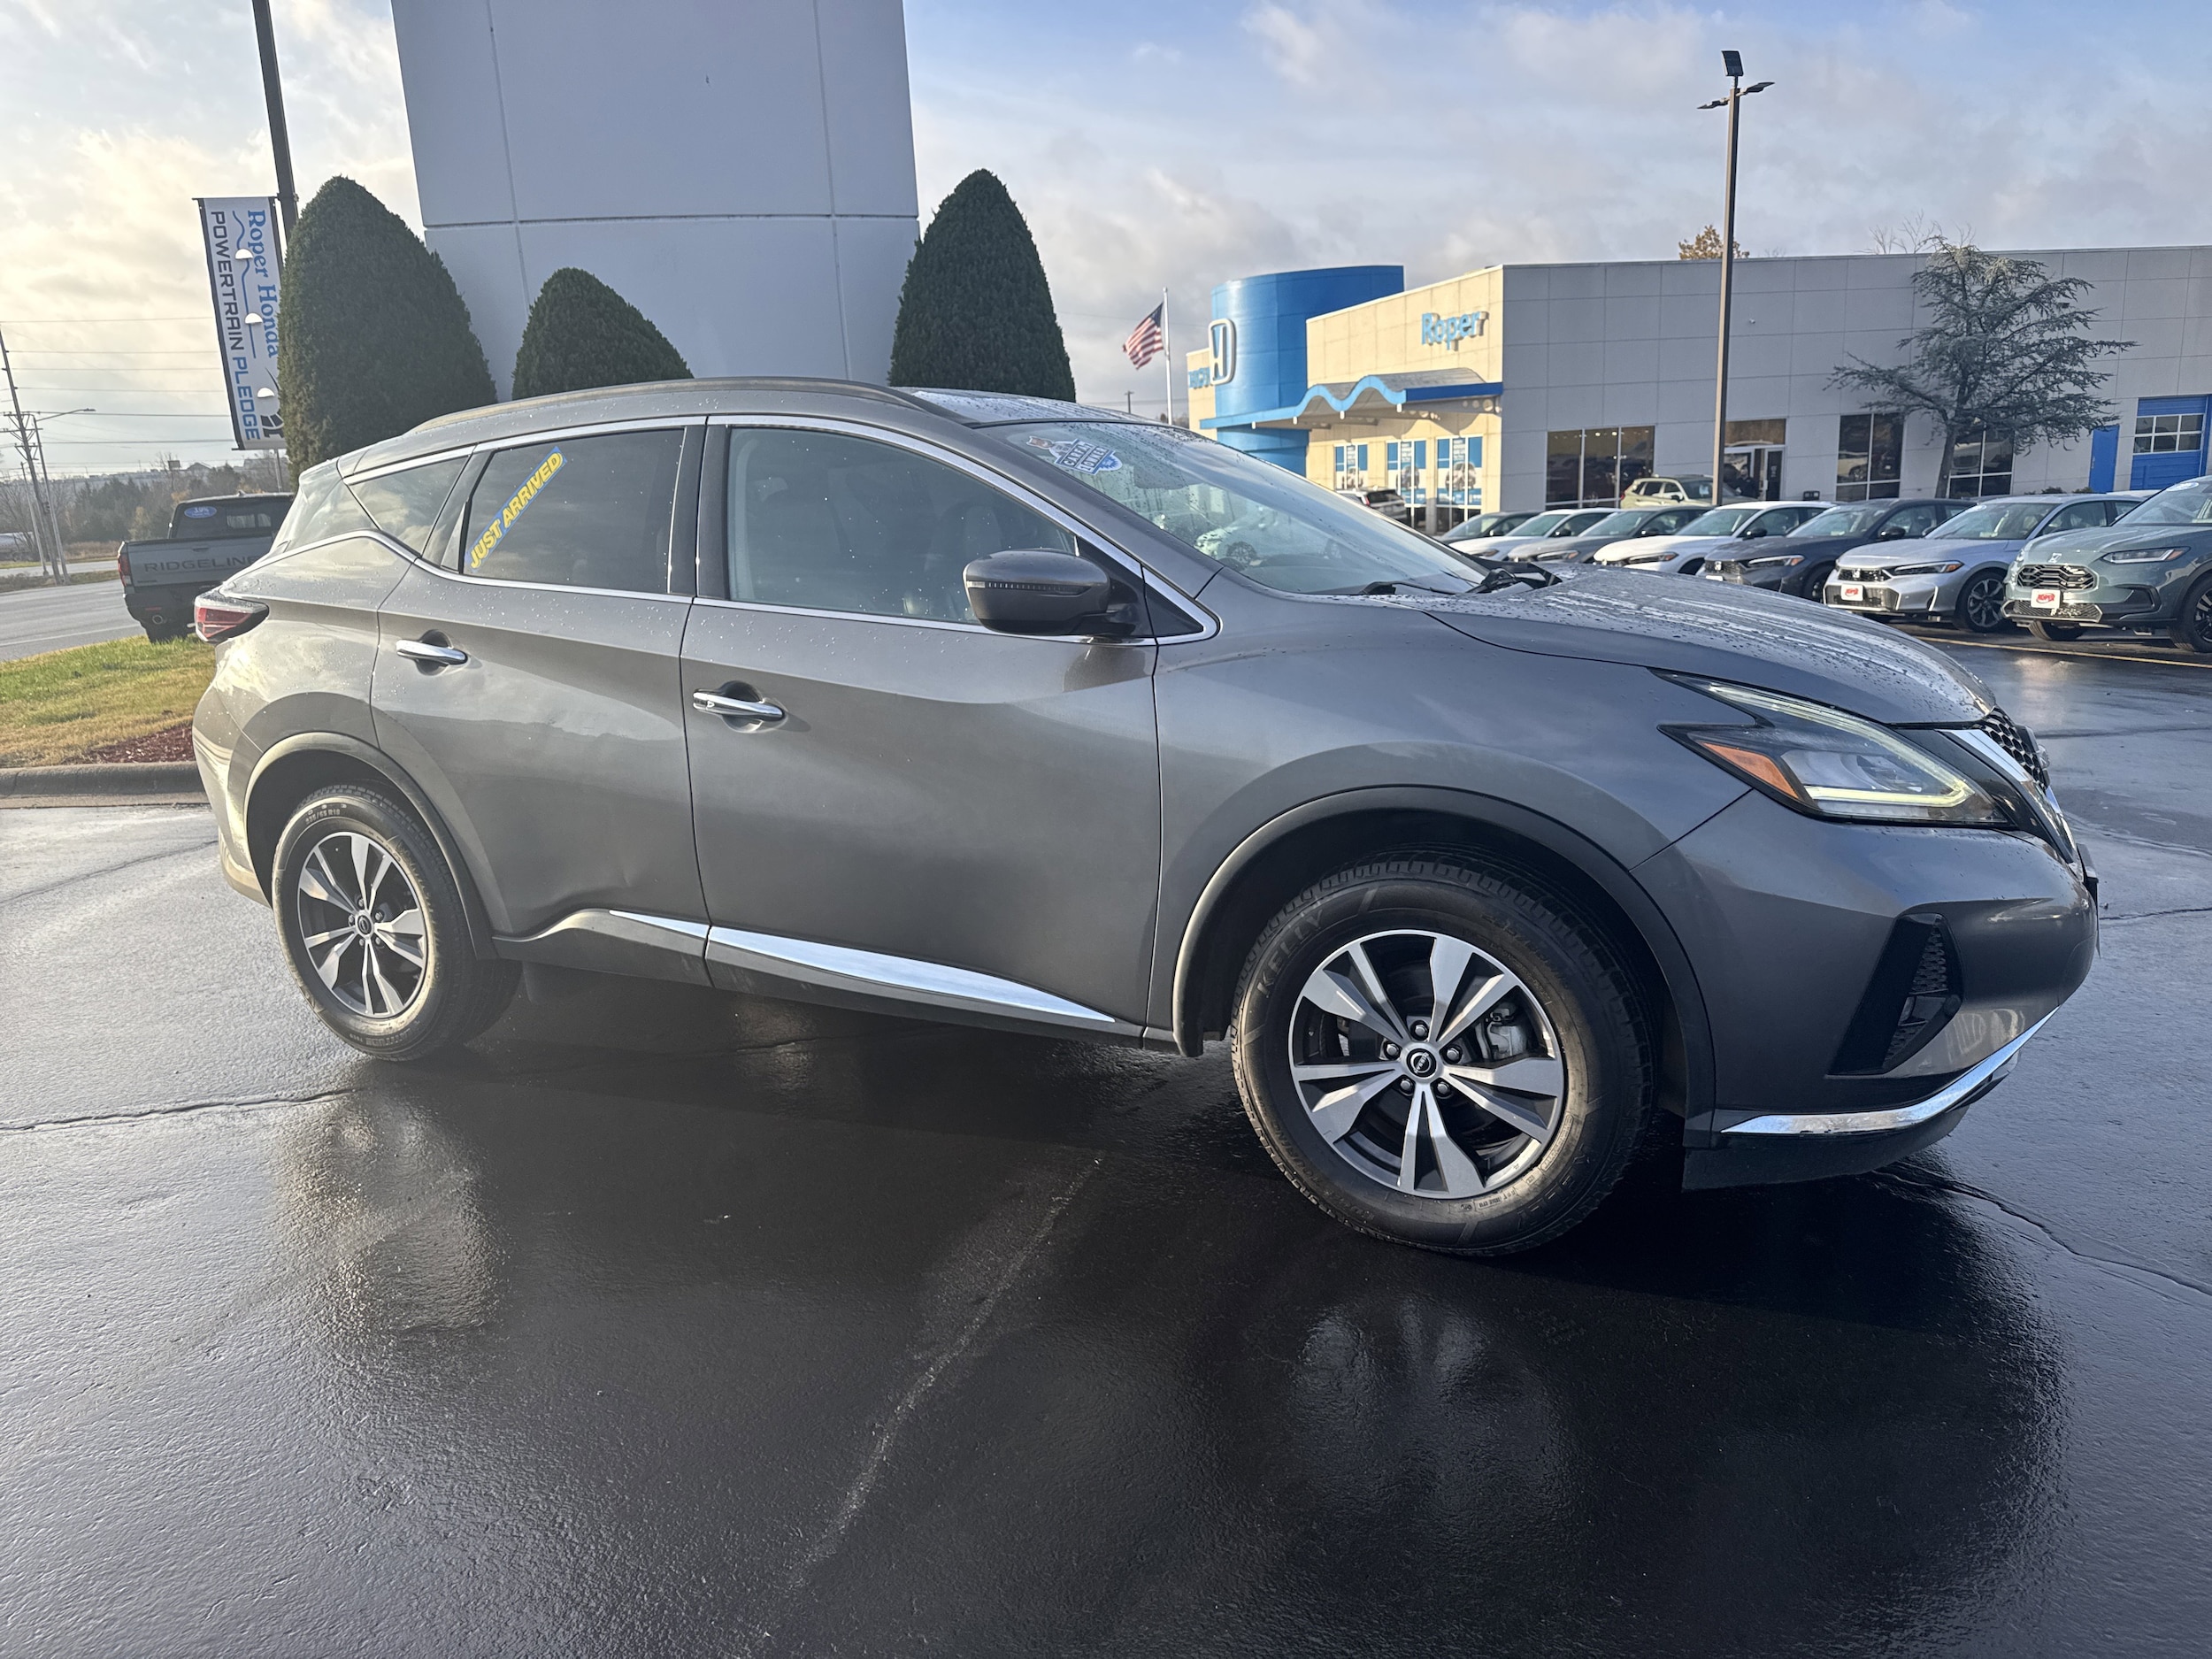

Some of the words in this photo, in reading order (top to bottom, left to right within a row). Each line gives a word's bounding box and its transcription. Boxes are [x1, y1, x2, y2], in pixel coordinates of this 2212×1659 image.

[247, 209, 269, 279] Roper
[211, 211, 245, 351] POWERTRAIN
[232, 356, 261, 441] PLEDGE
[257, 283, 279, 358] Honda
[1421, 311, 1489, 352] Roper
[470, 518, 503, 569] JUST
[502, 452, 564, 528] ARRIVED
[1256, 909, 1323, 999] KELLY
[1413, 1051, 1430, 1074] NISSAN
